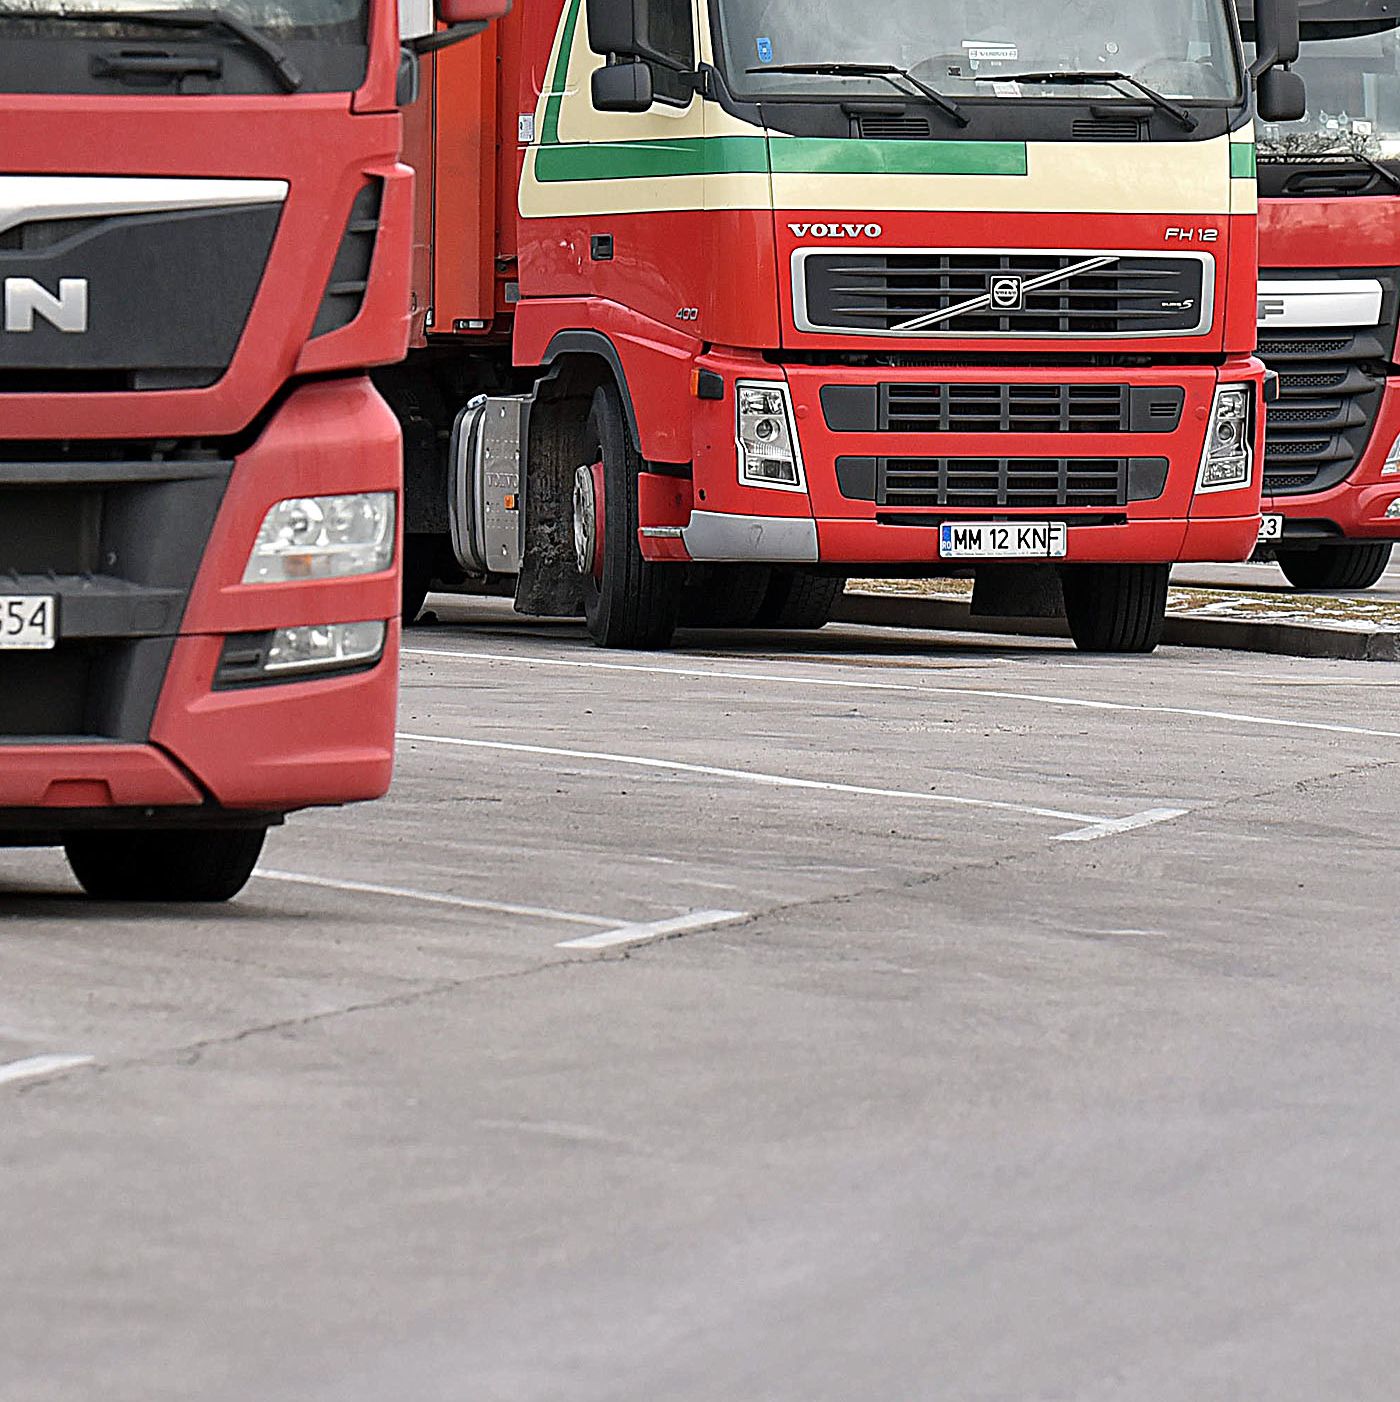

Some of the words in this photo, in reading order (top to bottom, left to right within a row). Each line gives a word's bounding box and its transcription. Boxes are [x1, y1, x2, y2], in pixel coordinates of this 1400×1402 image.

[787, 223, 882, 239] VOLVO
[1164, 227, 1194, 241] FH
[1197, 228, 1219, 242] 12
[675, 307, 699, 320] 400
[954, 528, 981, 550] MM
[990, 528, 1009, 550] 12
[1017, 527, 1062, 550] KNF
